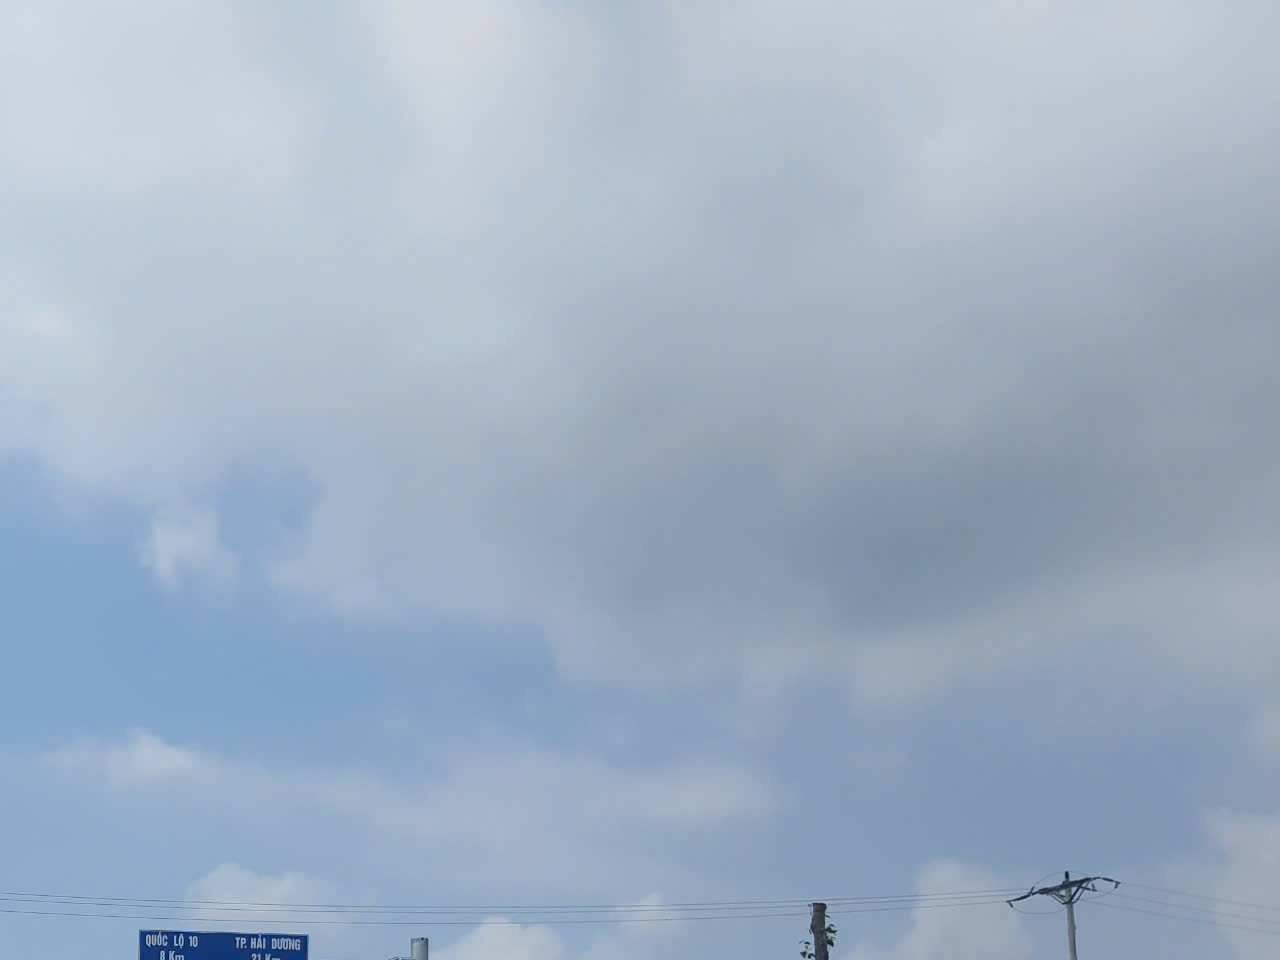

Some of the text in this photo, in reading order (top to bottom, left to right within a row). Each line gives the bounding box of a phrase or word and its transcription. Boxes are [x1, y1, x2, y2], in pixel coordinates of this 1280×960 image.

[145, 931, 199, 949] QUỐC LỘ 10
[235, 933, 301, 951] TP. HẢI DƯƠNG
